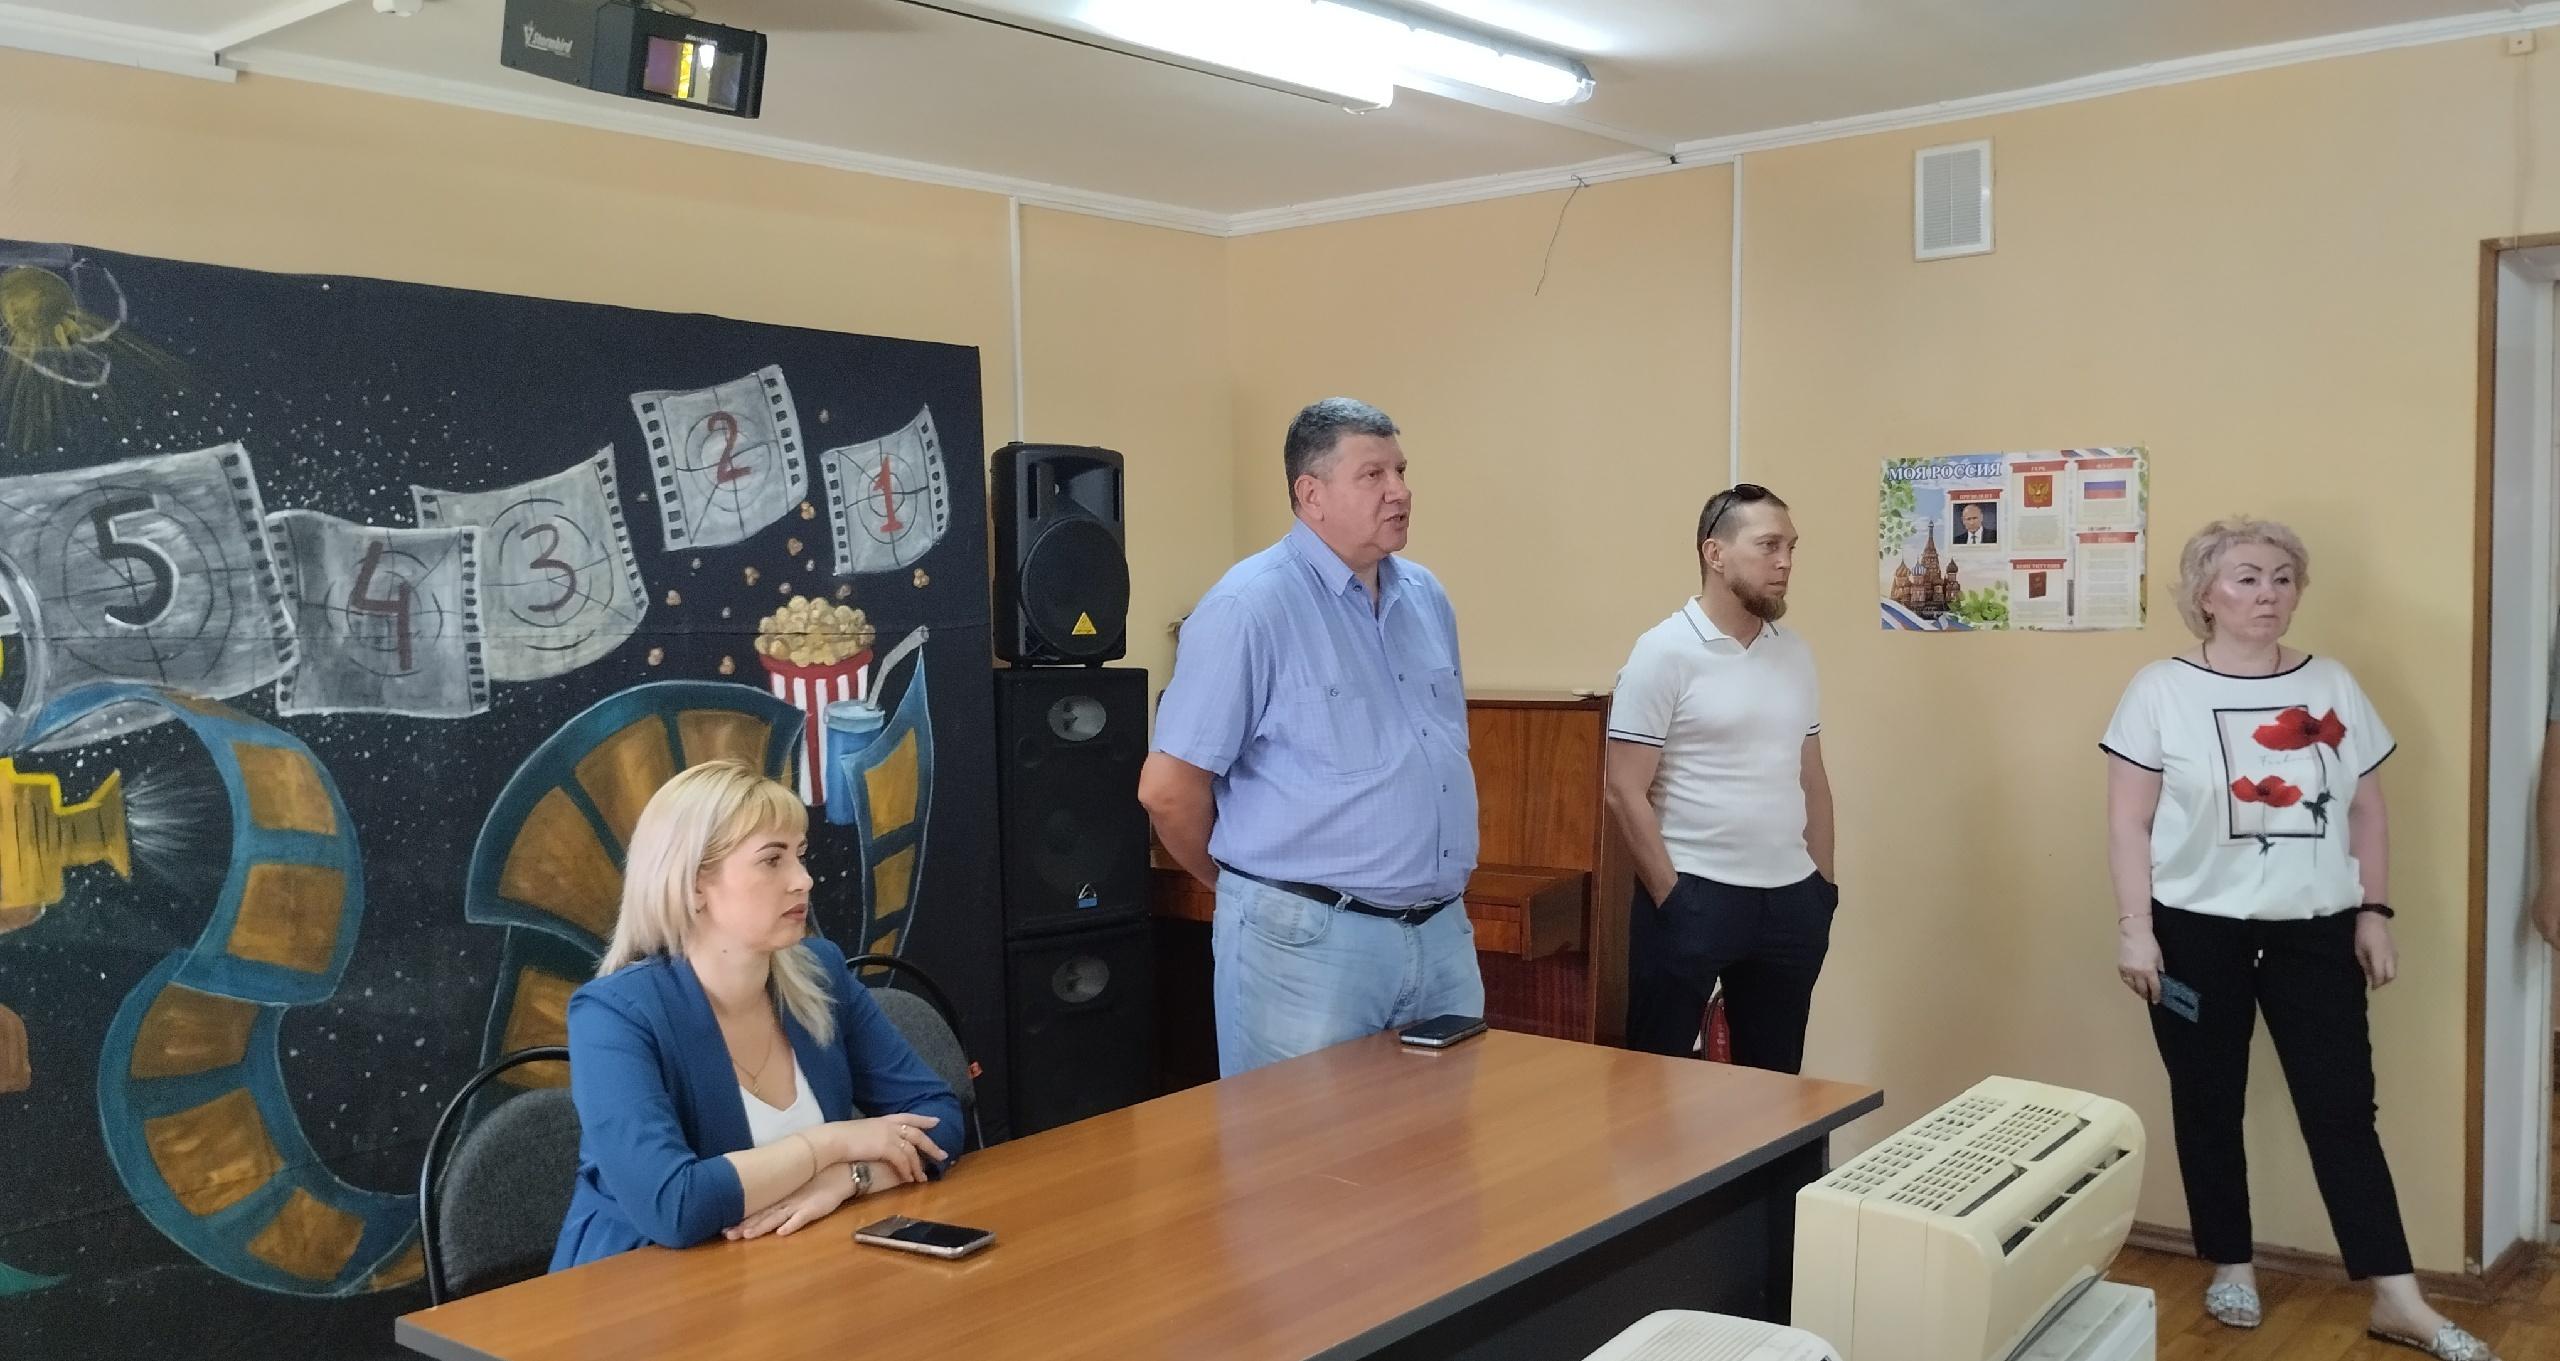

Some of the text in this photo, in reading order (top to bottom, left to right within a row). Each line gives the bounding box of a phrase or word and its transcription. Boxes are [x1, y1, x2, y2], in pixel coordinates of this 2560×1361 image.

[708, 410, 752, 485] 2
[1888, 463, 2002, 481] МОЯ РОССИЯ
[873, 455, 904, 533] 1
[89, 492, 180, 630] 5
[521, 523, 577, 613] 3
[349, 540, 413, 671] 4
